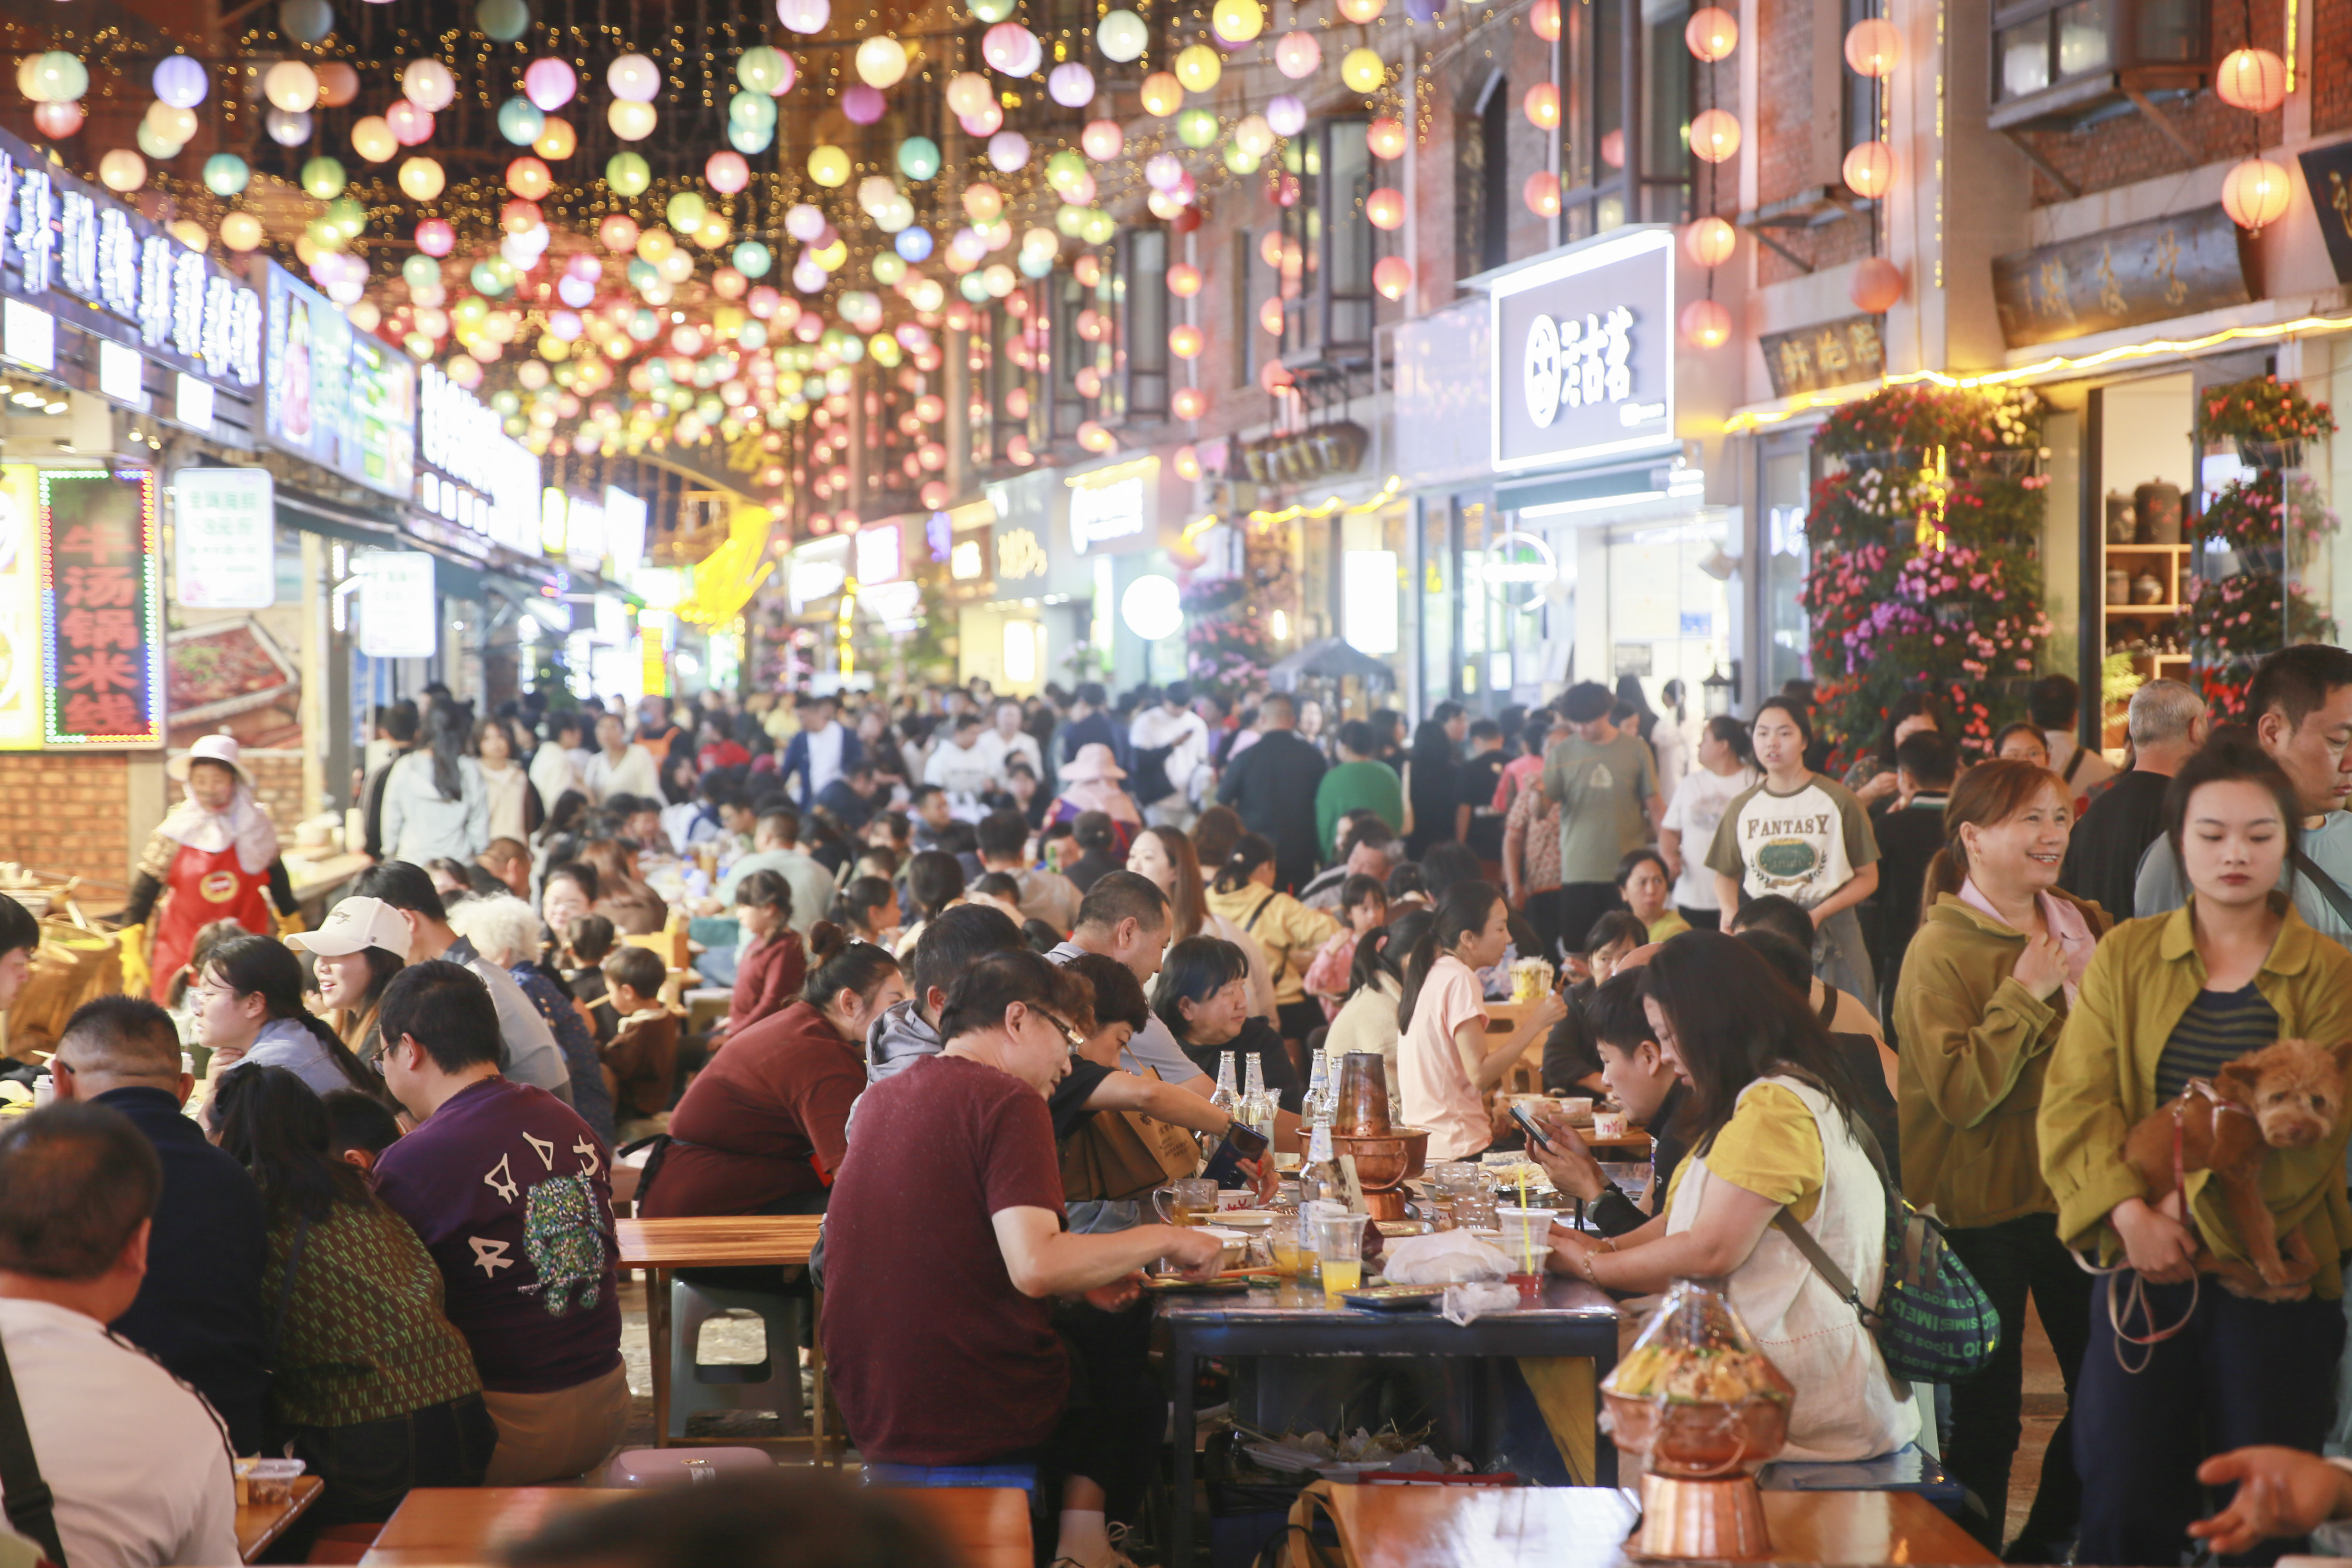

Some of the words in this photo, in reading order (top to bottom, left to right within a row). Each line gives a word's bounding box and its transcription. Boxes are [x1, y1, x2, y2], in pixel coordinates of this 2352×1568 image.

[59, 523, 142, 734] 牛汤锅米线
[1747, 814, 1829, 839] FANTASY
